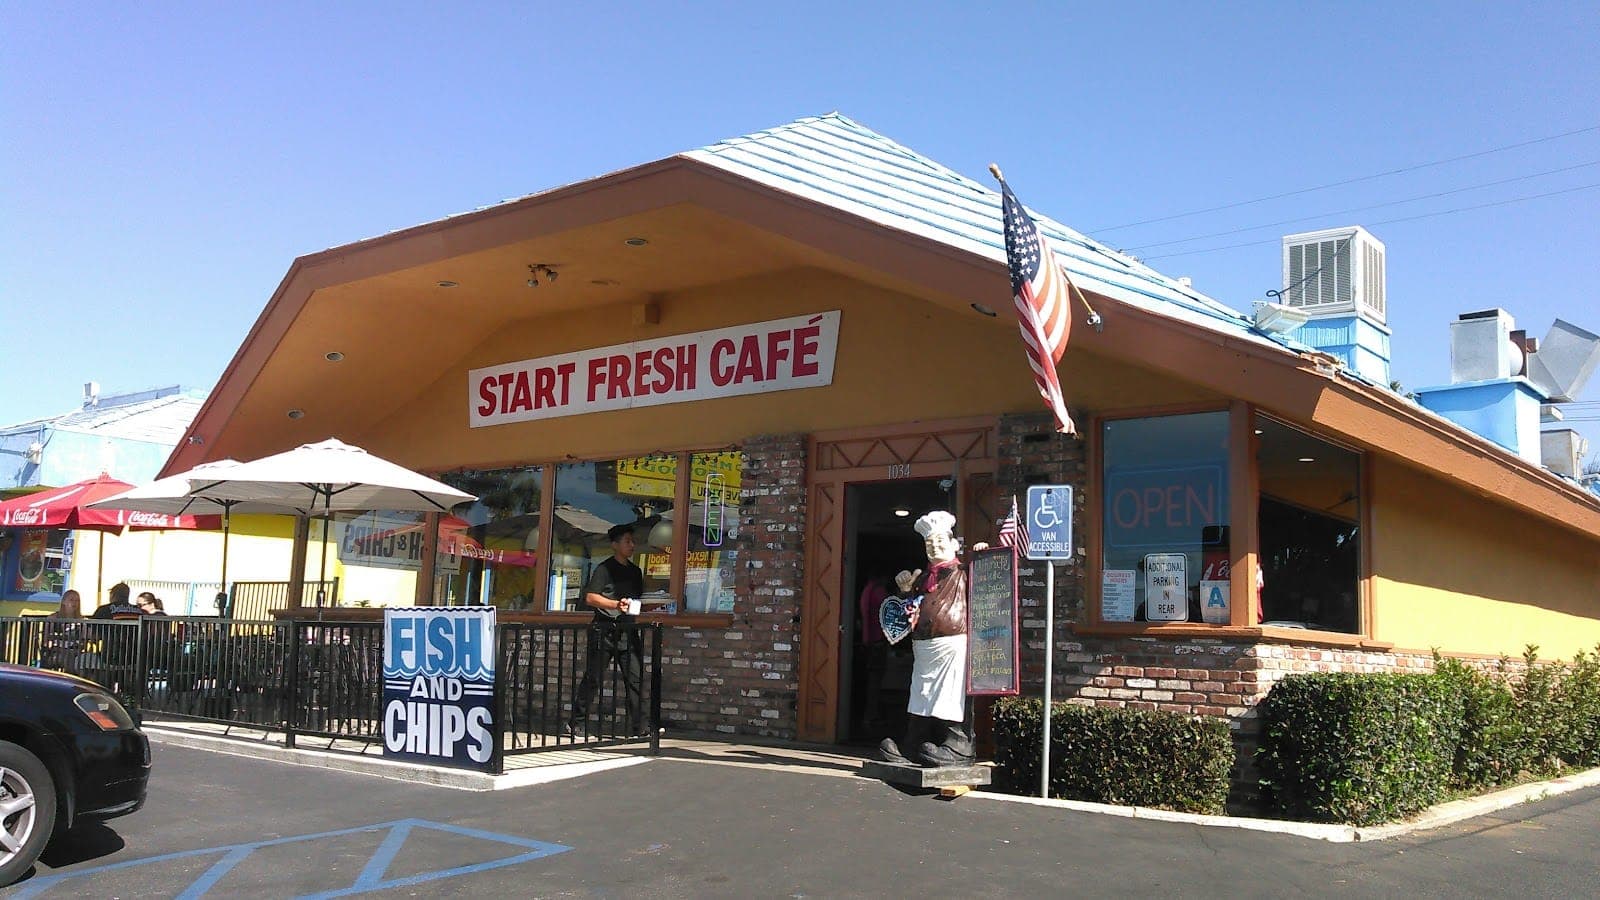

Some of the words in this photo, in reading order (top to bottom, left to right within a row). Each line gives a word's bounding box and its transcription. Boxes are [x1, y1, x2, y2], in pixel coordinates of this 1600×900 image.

[478, 362, 576, 417] START
[587, 344, 698, 402] FRESH
[710, 314, 823, 387] CAFÉ
[888, 464, 910, 480] 1034
[708, 478, 722, 543] OPEN
[1113, 484, 1215, 529] OPEN
[1041, 531, 1057, 542] VAN
[1029, 541, 1070, 553] ACCESSIBLE
[1148, 562, 1184, 572] ADDITIONAL
[1153, 576, 1180, 587] PARKING
[1162, 591, 1170, 600] IN
[1207, 586, 1226, 607] A
[1158, 604, 1175, 614] REAR
[389, 616, 484, 672] FISH
[410, 676, 463, 701] AND
[385, 699, 494, 763] CHIPS
